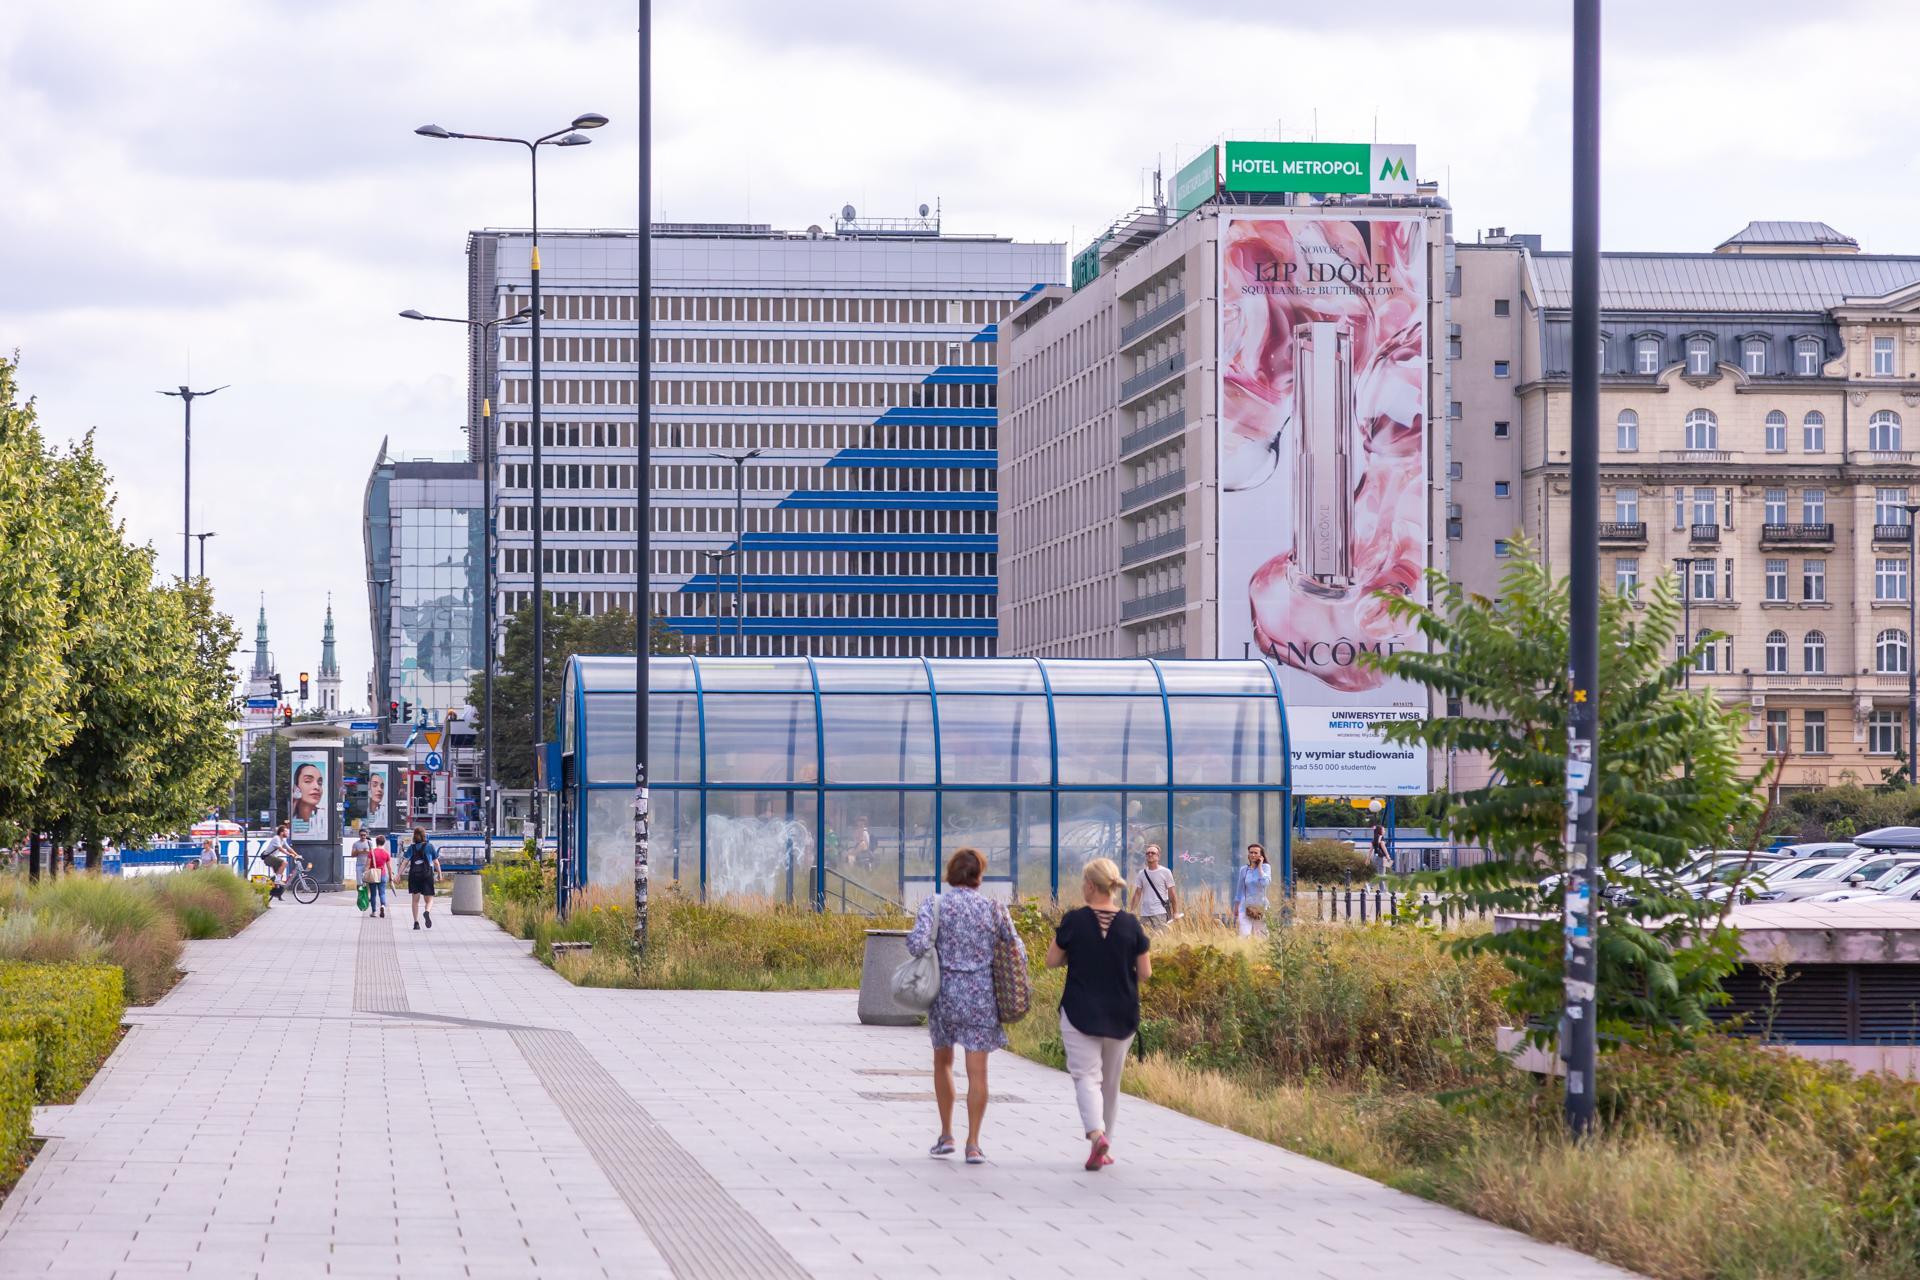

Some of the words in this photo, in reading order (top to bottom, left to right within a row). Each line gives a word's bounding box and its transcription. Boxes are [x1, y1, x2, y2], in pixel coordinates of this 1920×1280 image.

[1232, 159, 1278, 174] HOTEL
[1282, 160, 1363, 176] METROPOL
[1254, 262, 1298, 282] LIP
[1307, 257, 1392, 283] IDÔLE
[1241, 285, 1316, 295] SQUALANE-12
[1331, 711, 1397, 720] UNIWERSYTET
[1399, 712, 1420, 720] WSB
[1329, 721, 1364, 729] MERITO
[1305, 749, 1346, 761] wymiar
[1348, 749, 1415, 760] studiowania
[1309, 763, 1324, 771] 550
[1325, 763, 1340, 771] 000
[1340, 763, 1377, 771] studentów
